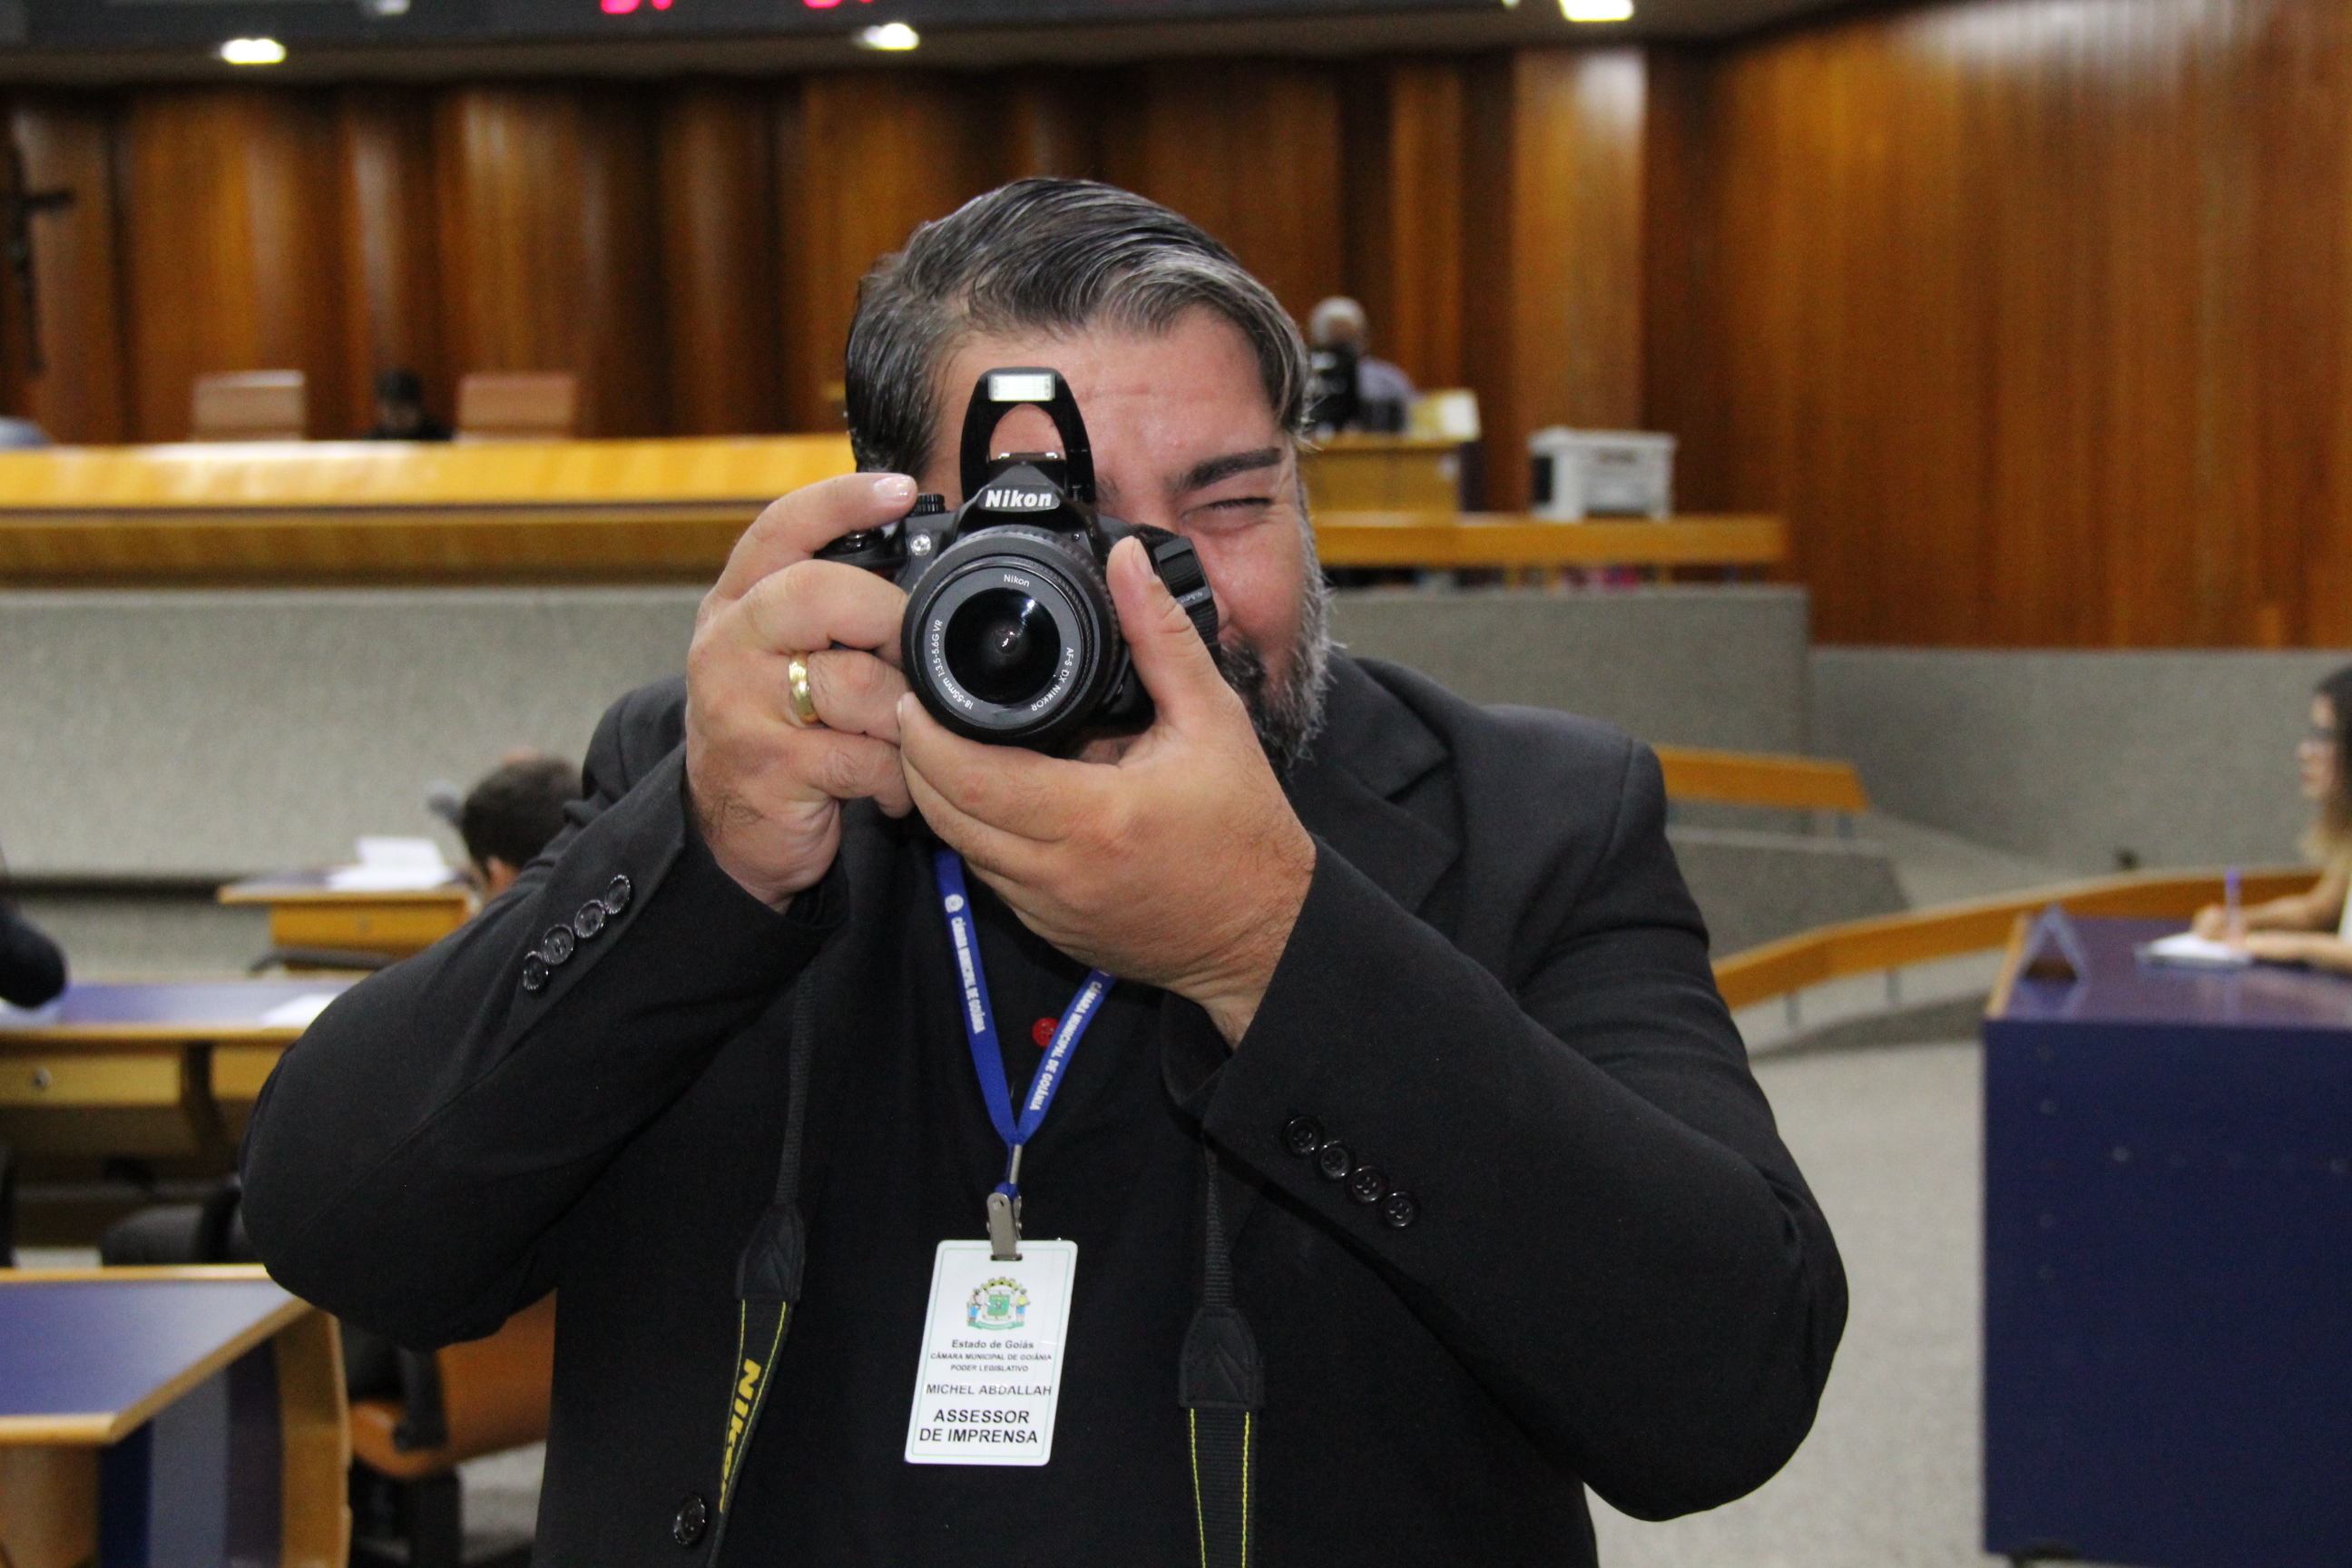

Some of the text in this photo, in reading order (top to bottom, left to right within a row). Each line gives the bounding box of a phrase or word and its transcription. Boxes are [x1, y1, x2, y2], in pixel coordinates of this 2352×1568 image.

[985, 490, 1052, 507] Nikon
[1004, 574, 1030, 587] Nikon
[933, 619, 943, 632] VR
[1030, 647, 1074, 711] AF-S DX NIKKOR
[943, 677, 974, 710] 18-55mm
[1051, 1012, 1083, 1058] MUNICIPAL
[1045, 1058, 1059, 1073] DE
[1029, 1073, 1053, 1111] GOIÂNIA
[952, 1339, 986, 1348] Estado
[1005, 1340, 1034, 1349] Goiás
[926, 1384, 1052, 1396] MICHEL ABDALLAH
[934, 1409, 1030, 1424] ASSESSOR
[919, 1428, 1038, 1443] DE IMPRENSA
